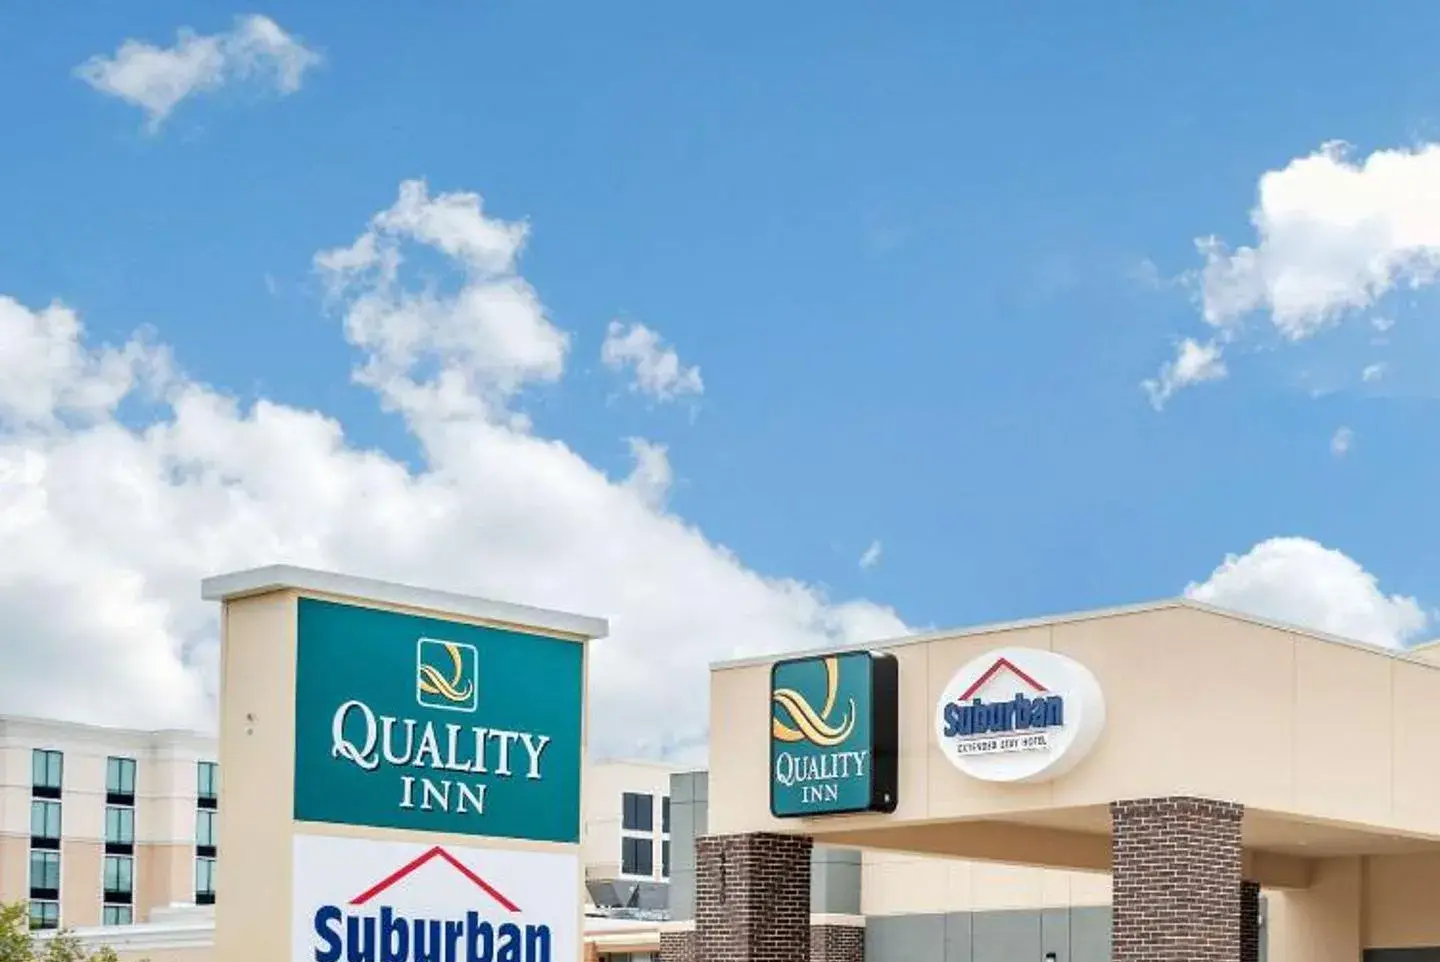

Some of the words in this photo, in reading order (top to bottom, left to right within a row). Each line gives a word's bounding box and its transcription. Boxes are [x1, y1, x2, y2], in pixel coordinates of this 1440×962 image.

[943, 692, 1064, 738] Suburban
[331, 699, 550, 779] QUALITY
[776, 750, 868, 786] QUALITY
[399, 776, 487, 815] INN
[800, 783, 839, 803] INN
